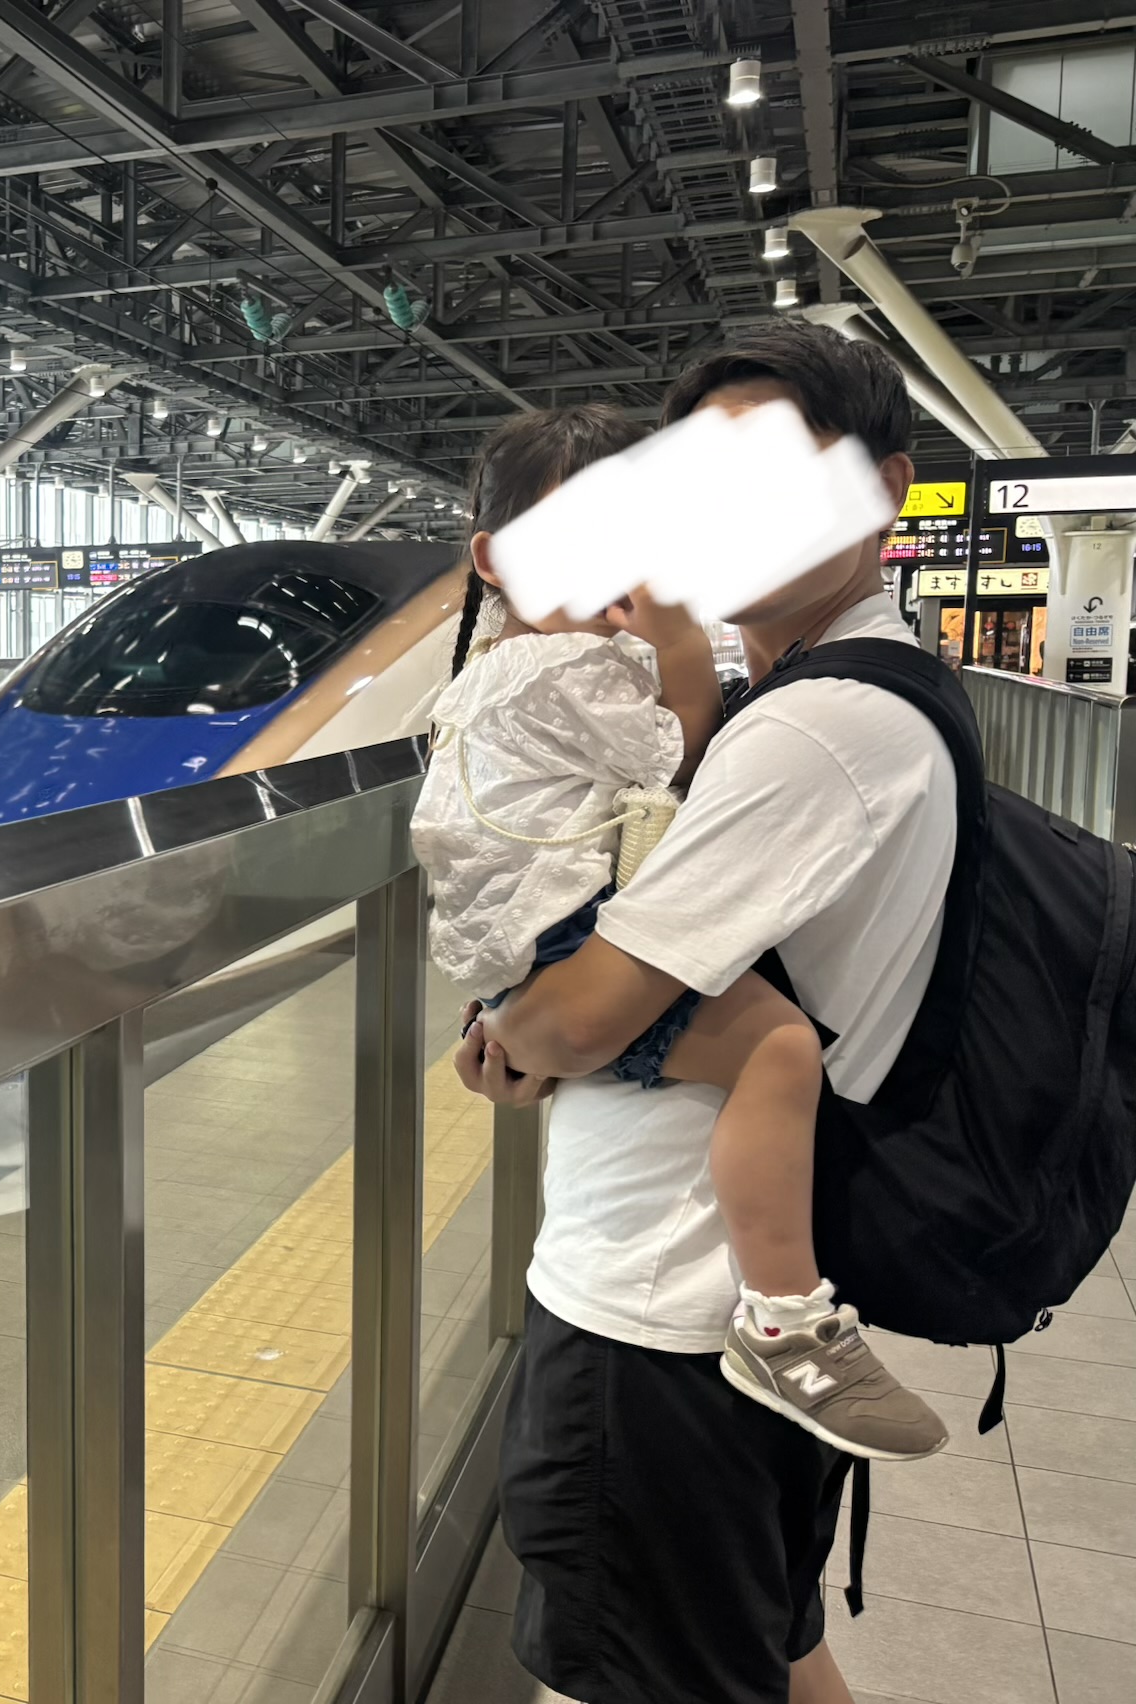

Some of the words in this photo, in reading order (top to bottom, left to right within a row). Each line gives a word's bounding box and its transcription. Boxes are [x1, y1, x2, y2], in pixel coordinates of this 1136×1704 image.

[997, 484, 1029, 509] 12
[930, 574, 1012, 590] ますすし
[1073, 626, 1110, 637] 自由席
[782, 1359, 838, 1398] N
